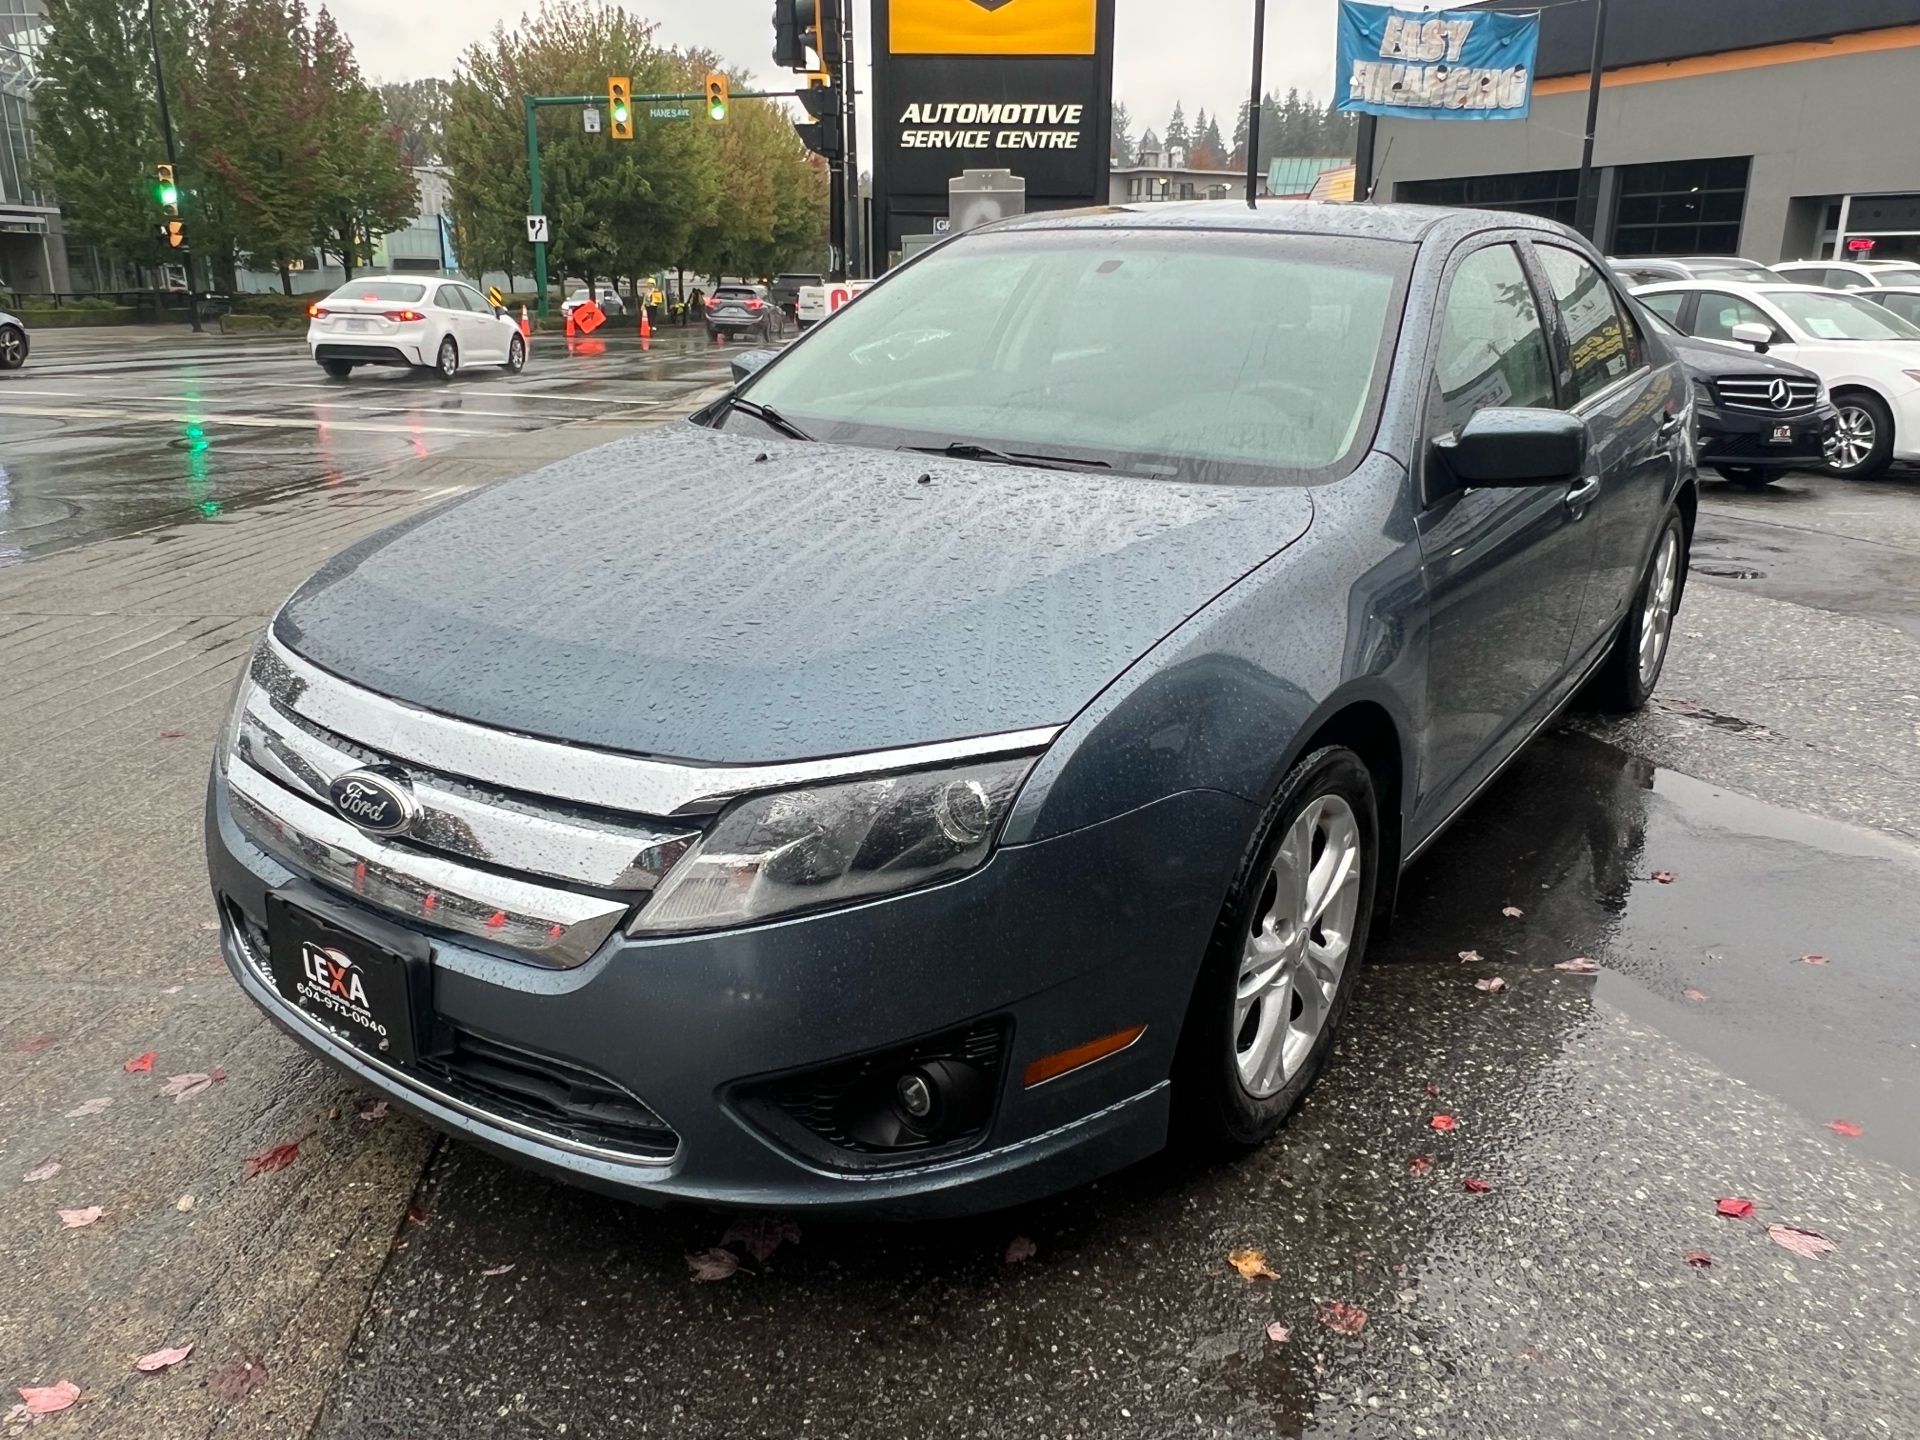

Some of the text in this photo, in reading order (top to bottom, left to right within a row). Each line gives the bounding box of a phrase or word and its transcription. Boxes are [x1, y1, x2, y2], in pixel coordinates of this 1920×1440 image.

[1379, 15, 1473, 62] EASY
[650, 108, 677, 118] HANES
[899, 103, 1083, 125] AUTOMOTIVE
[900, 130, 1080, 149] SERVICE CENTRE
[340, 781, 388, 821] Ford
[302, 947, 370, 1009] LEXA
[296, 982, 387, 1036] 604-971-0040
